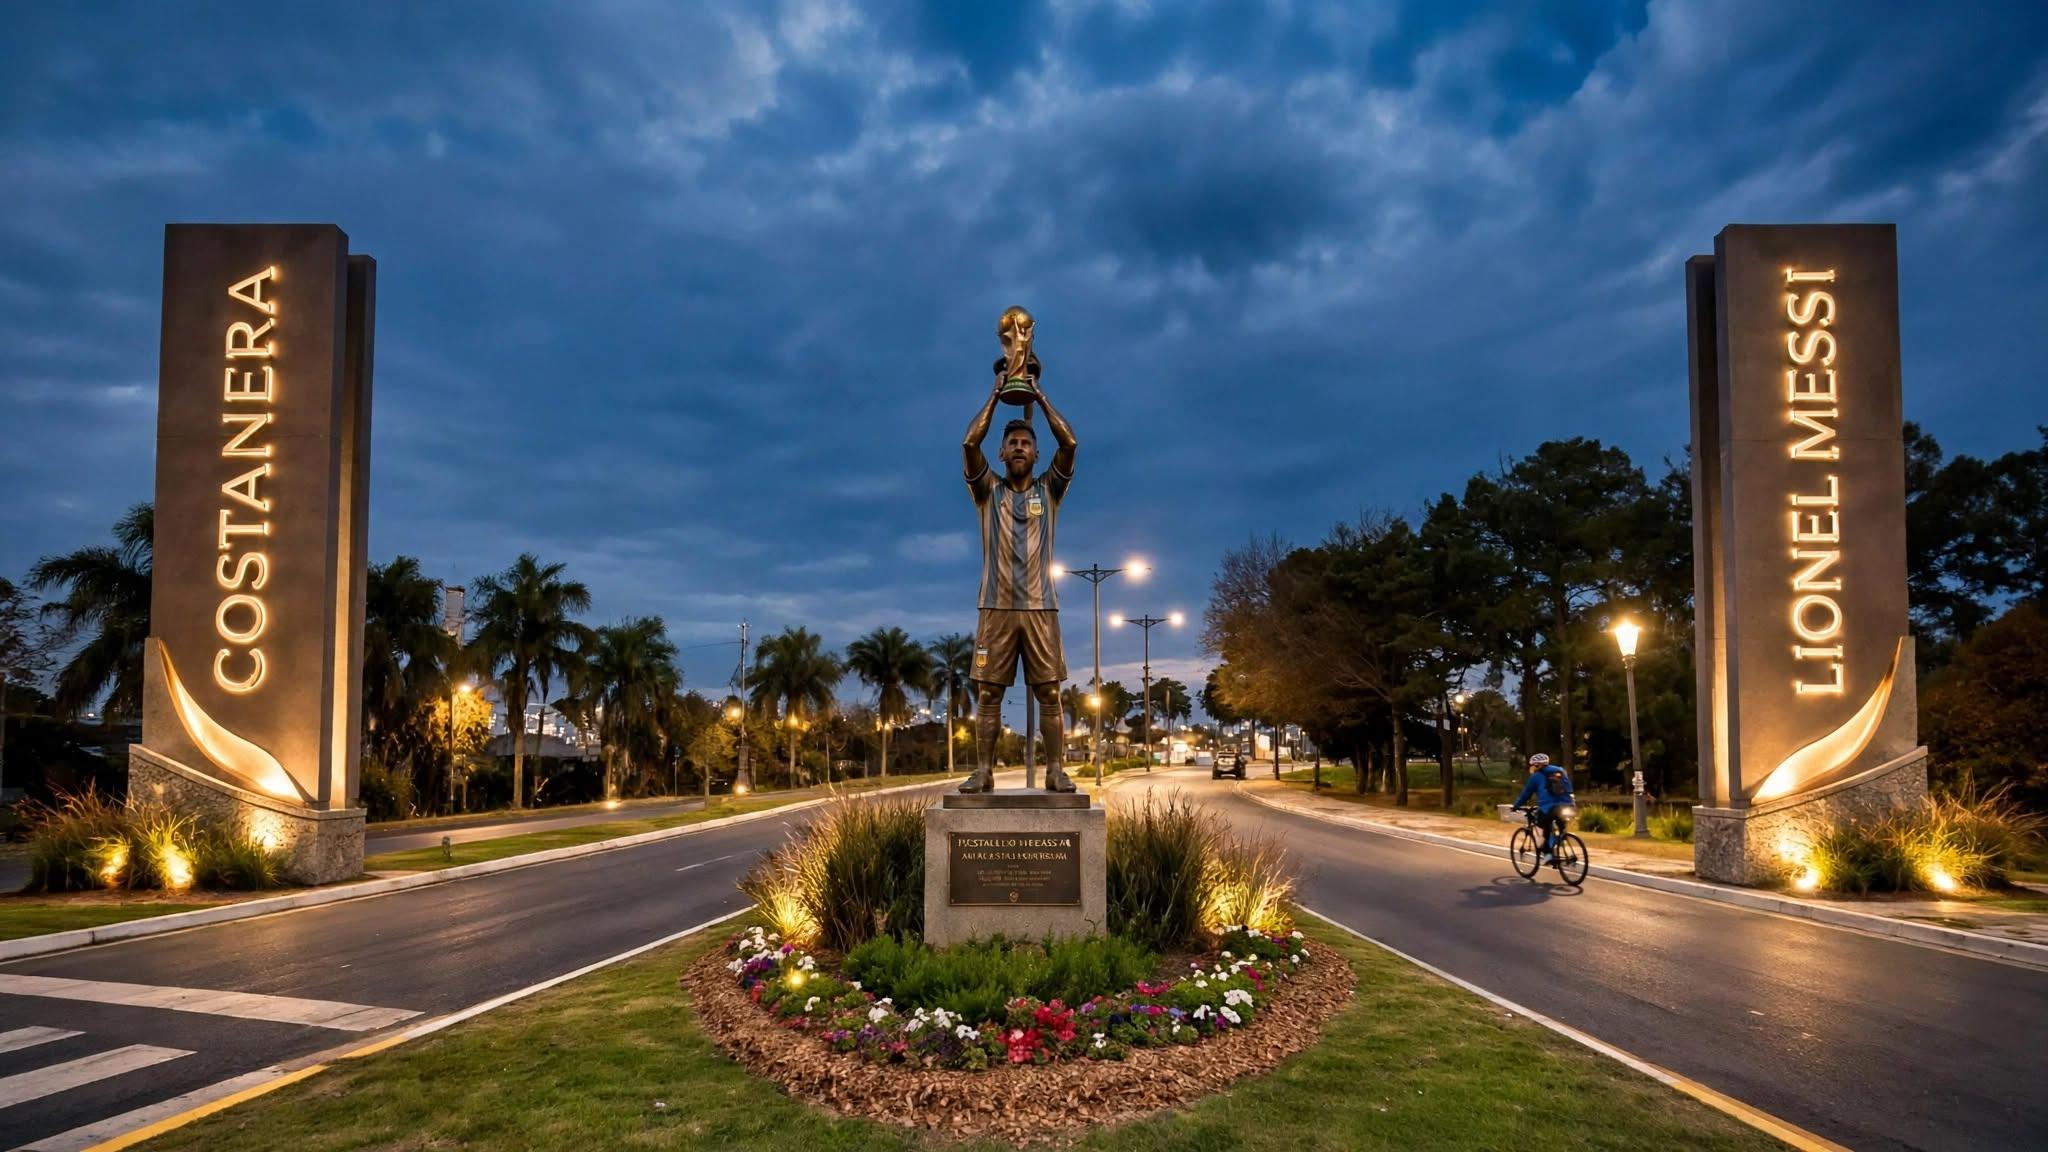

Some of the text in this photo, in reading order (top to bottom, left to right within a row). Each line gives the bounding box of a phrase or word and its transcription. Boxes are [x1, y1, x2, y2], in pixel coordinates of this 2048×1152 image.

[214, 266, 275, 692] COSTANERA
[1785, 268, 1843, 694] LIONEL MESSI
